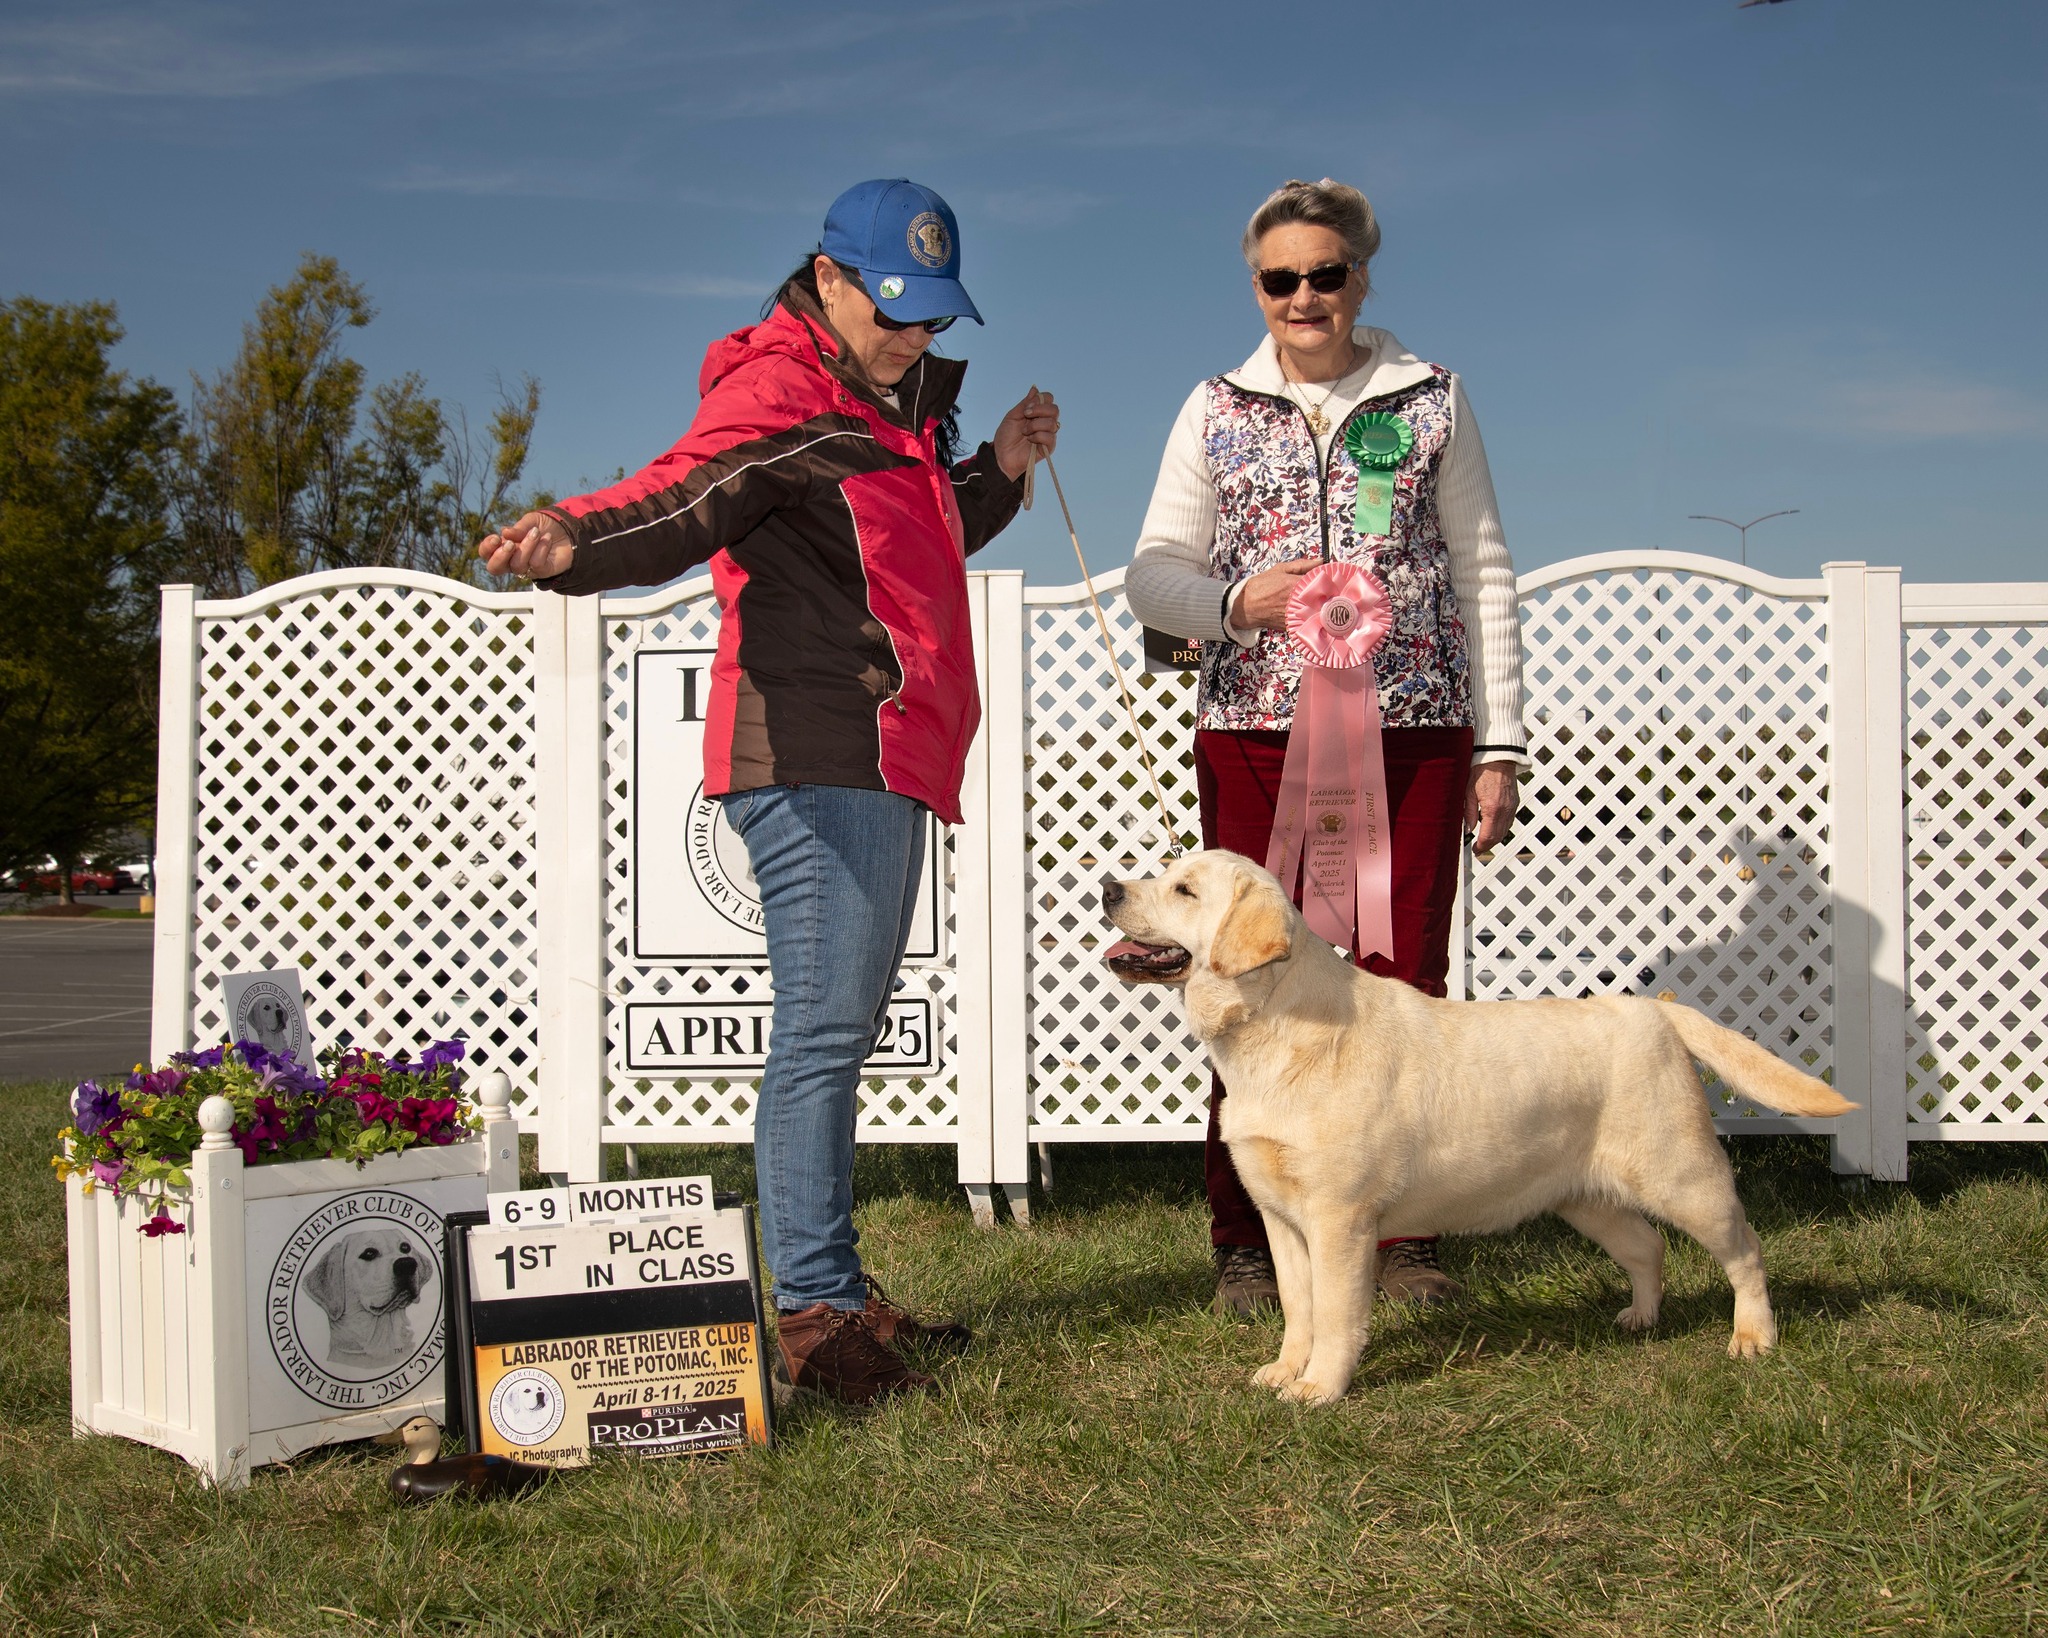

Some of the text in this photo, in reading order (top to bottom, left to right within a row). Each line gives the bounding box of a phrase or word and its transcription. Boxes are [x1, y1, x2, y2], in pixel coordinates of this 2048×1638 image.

[1331, 606, 1350, 626] AKC
[1308, 798, 1356, 806] RETRIEVER
[1365, 792, 1378, 855] FIRST PLACE
[1330, 839, 1336, 847] of
[694, 822, 743, 915] LABRADOR
[1311, 860, 1331, 868] April
[1319, 869, 1340, 878] 2025
[743, 906, 764, 926] HE
[239, 986, 261, 1021] RETRIEVER
[261, 984, 279, 995] CLUB
[279, 991, 287, 1001] OF
[286, 999, 297, 1018] THE
[641, 1014, 922, 1056] APRI 25
[364, 1196, 414, 1219] CLUB
[579, 1183, 704, 1214] MONTHS
[414, 1212, 440, 1235] OF
[275, 1199, 361, 1290] RETRIEVER
[495, 1225, 705, 1290] 1ST PLACE
[586, 1252, 735, 1288] IN CLASS
[273, 1294, 327, 1395] LABRADOR
[501, 1324, 751, 1367] LABRADOR RETRIEVER CLUB
[571, 1346, 753, 1381] OF THE POTOMAC, INC.
[327, 1383, 365, 1404] THE
[371, 1371, 411, 1400] INC.
[593, 1378, 738, 1410] April 8-11, 2025
[652, 1406, 690, 1416] PURINA
[523, 1445, 583, 1462] Photography
[640, 1442, 704, 1455] CHAMPION
